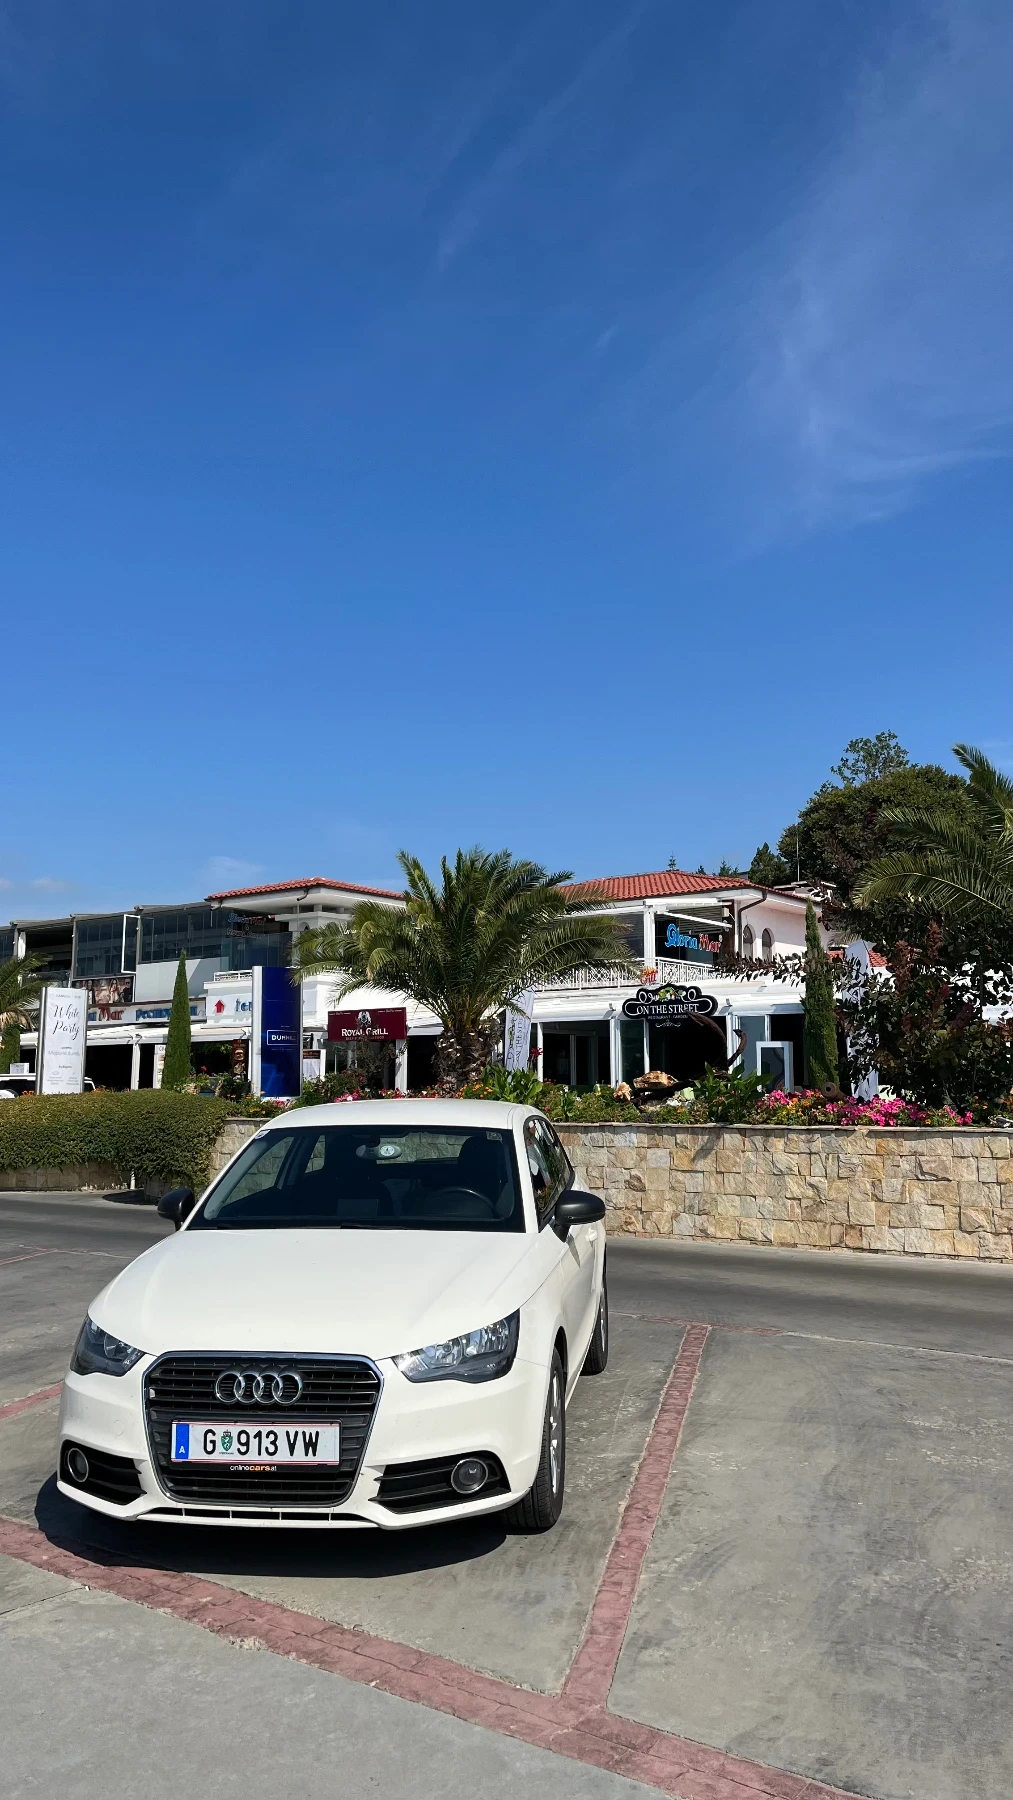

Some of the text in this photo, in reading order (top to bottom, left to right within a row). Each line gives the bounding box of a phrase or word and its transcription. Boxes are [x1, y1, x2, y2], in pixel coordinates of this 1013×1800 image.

[664, 923, 721, 953] Gloria Mar
[54, 1003, 80, 1019] White
[99, 1007, 125, 1021] Mar
[637, 1003, 700, 1015] ON THE STREET
[53, 1020, 80, 1040] Party
[341, 1027, 388, 1037] ROYAL GRILL
[178, 1446, 186, 1454] A
[203, 1428, 320, 1457] G 913 VW
